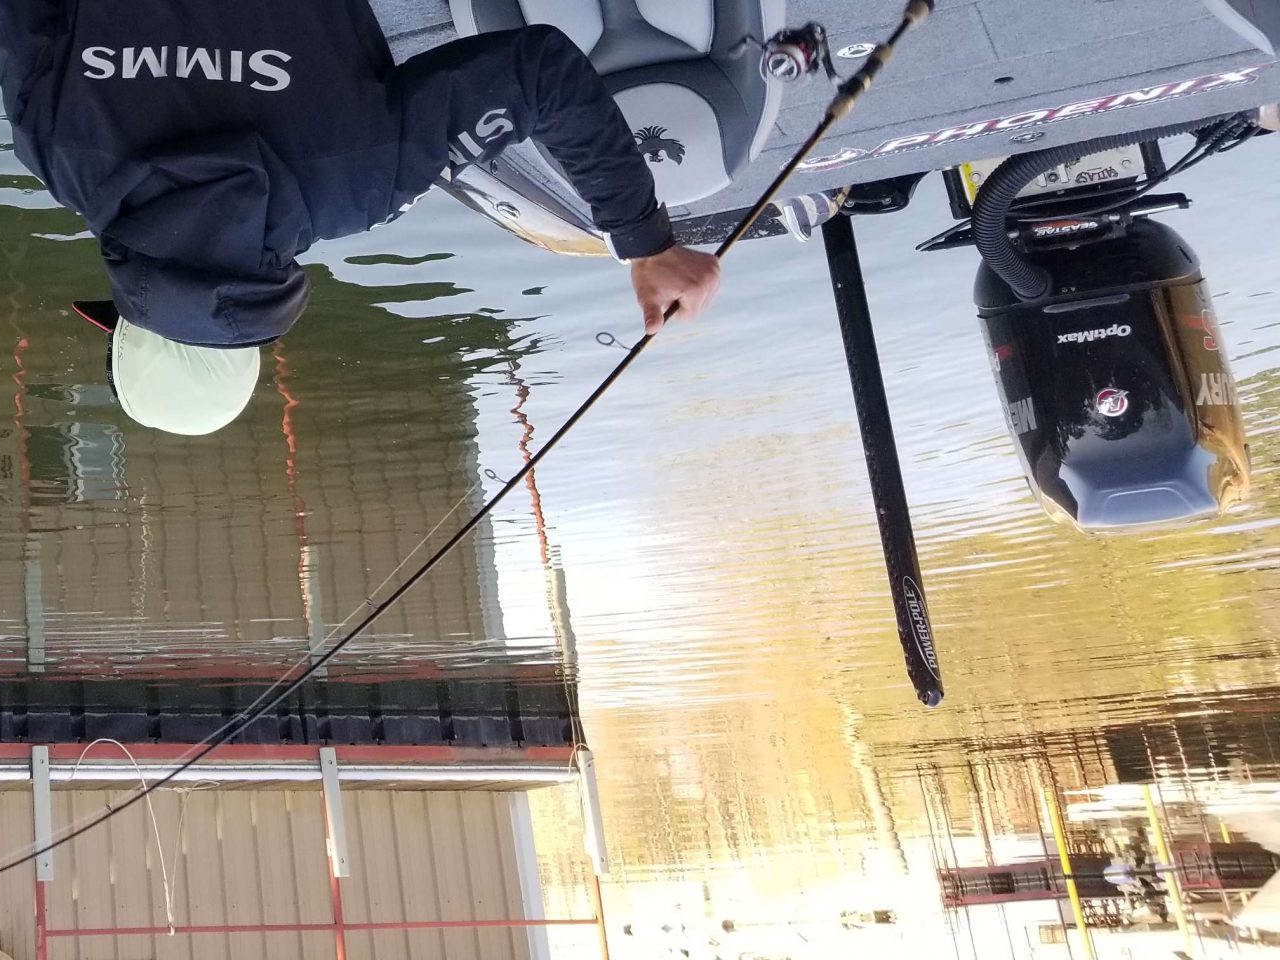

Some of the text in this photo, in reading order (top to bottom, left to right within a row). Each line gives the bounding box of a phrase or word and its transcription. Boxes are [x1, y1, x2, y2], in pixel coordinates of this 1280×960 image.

[80, 45, 293, 93] SIMMS
[875, 63, 1268, 156] PHOENIX
[1076, 167, 1117, 183] ATLAS
[1057, 323, 1131, 344] OptiMax
[905, 588, 938, 669] POWER-POLE
